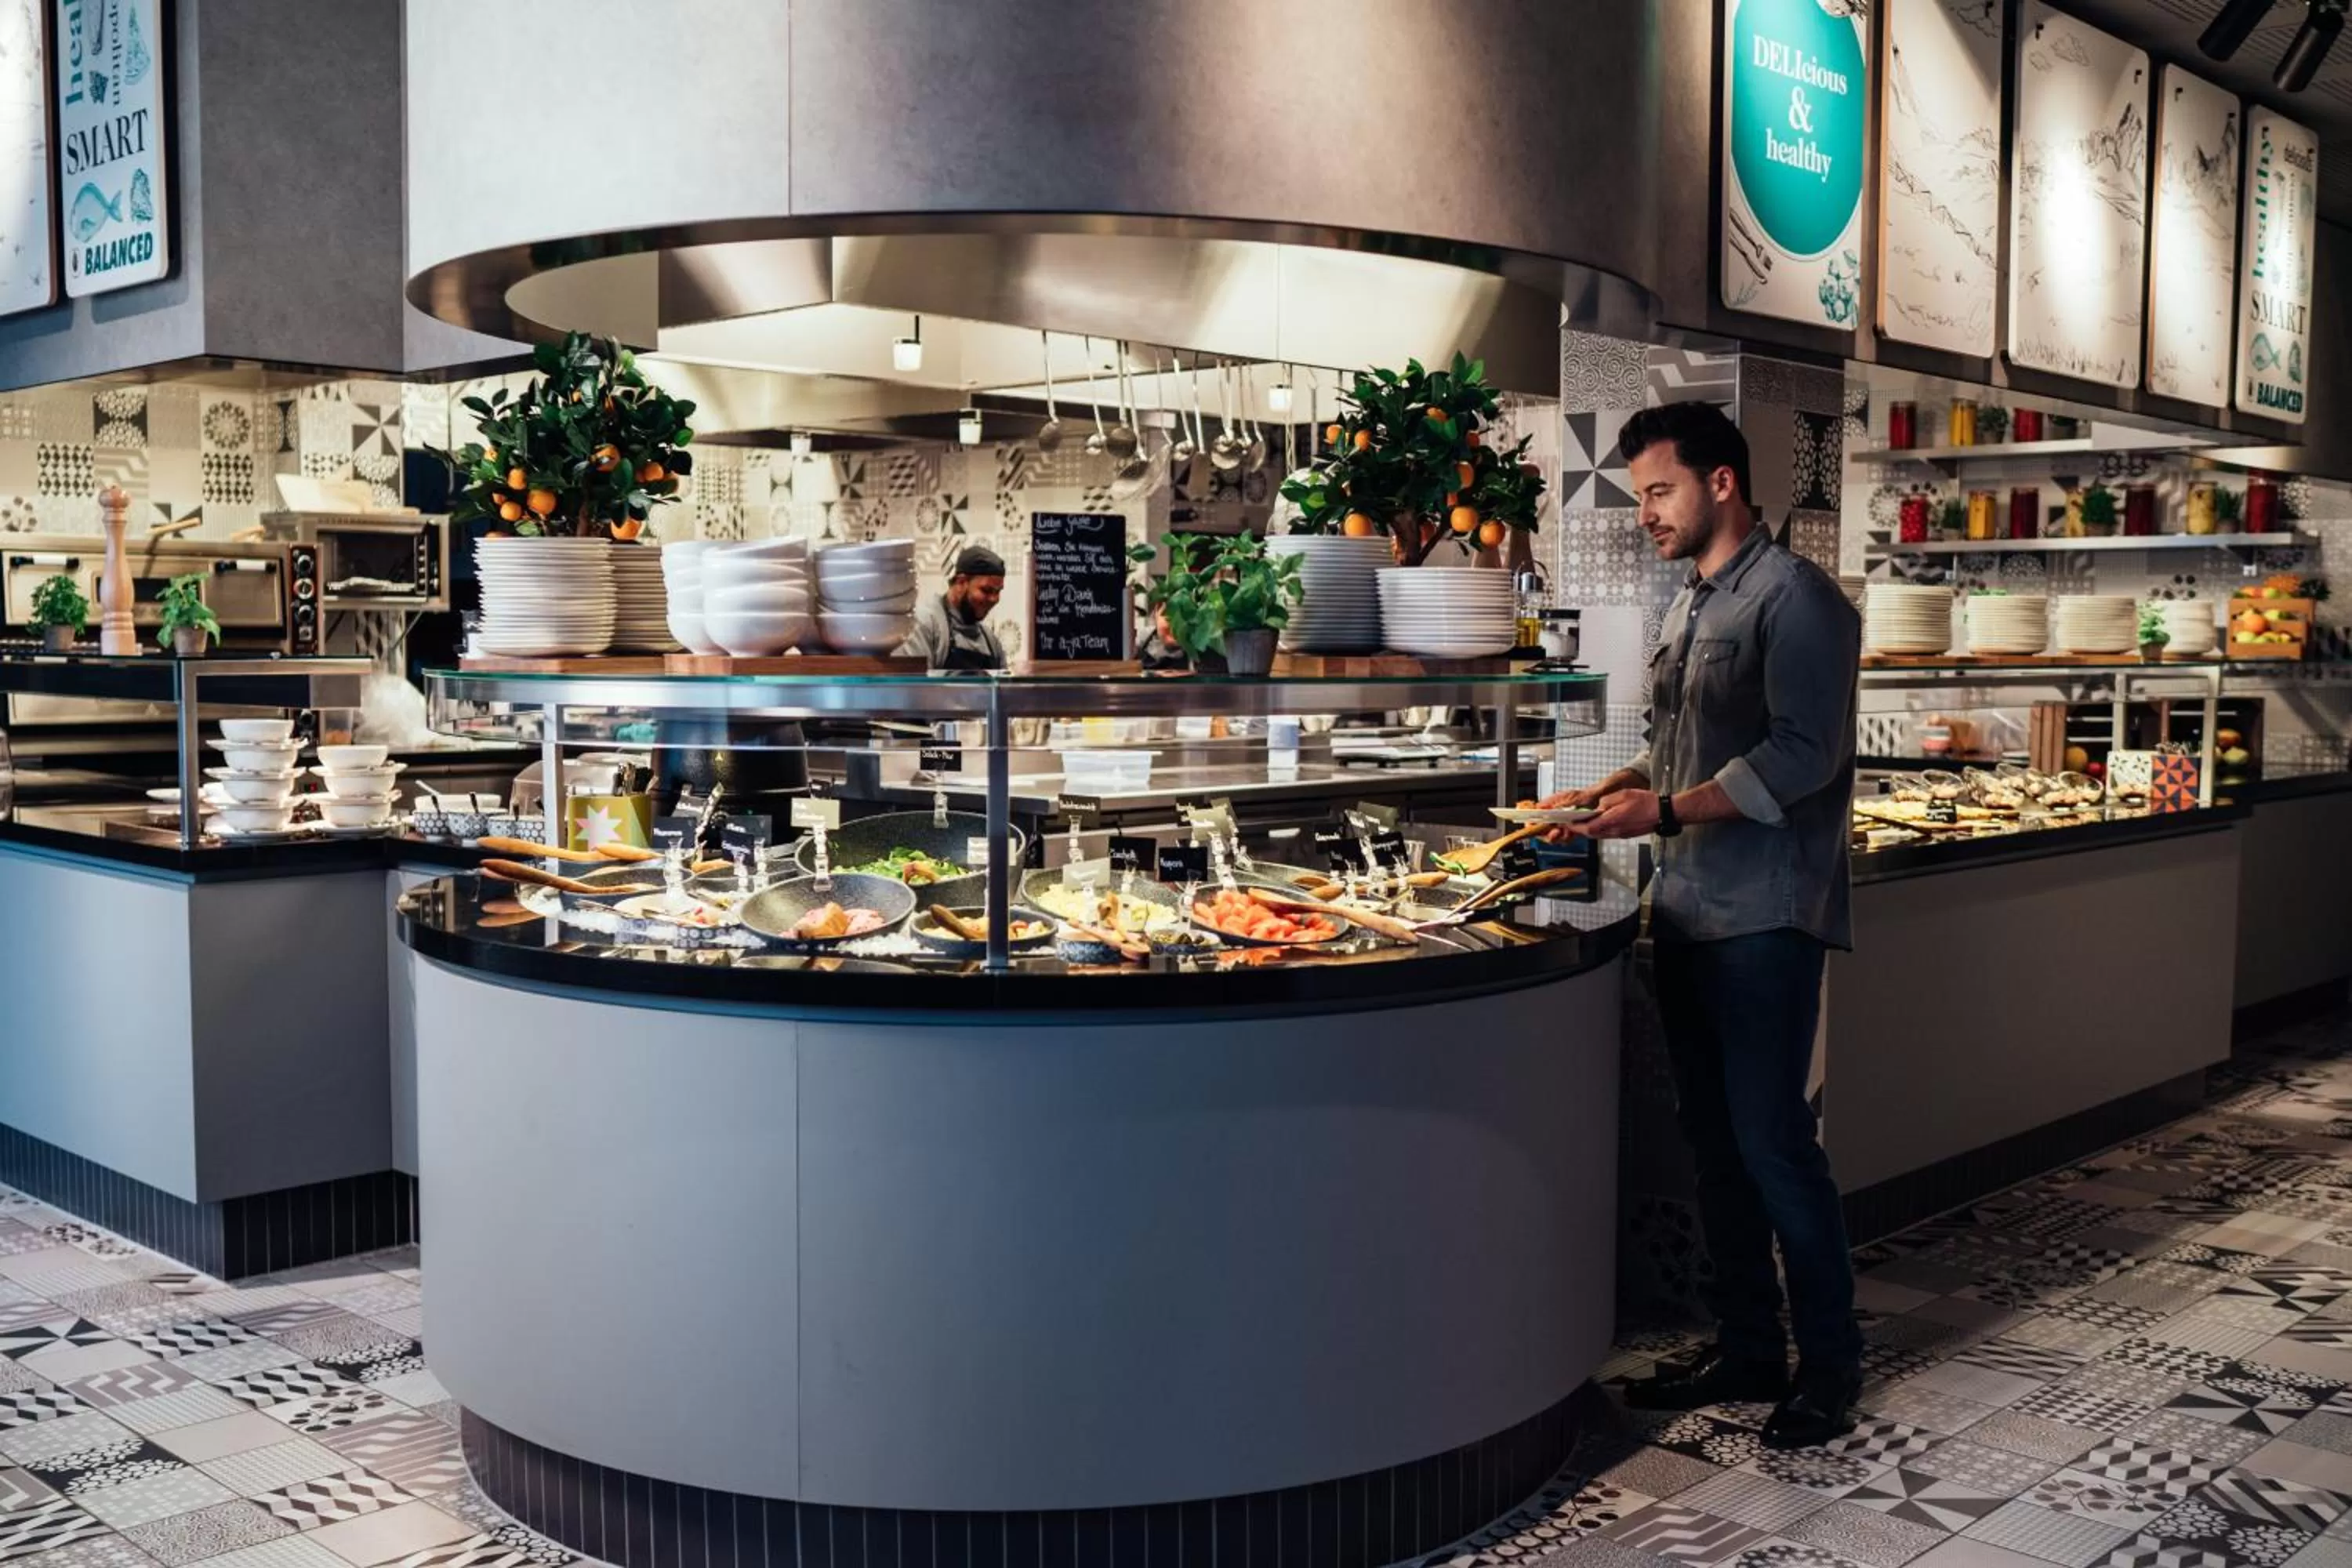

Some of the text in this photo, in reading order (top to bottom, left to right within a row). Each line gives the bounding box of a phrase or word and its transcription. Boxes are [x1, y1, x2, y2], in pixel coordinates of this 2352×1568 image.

[1788, 85, 1813, 133] &
[66, 108, 148, 176] SMART
[1766, 128, 1832, 183] healthy
[85, 232, 154, 275] BALANCED
[2250, 289, 2307, 336] SMART
[2257, 382, 2303, 414] BALANCED
